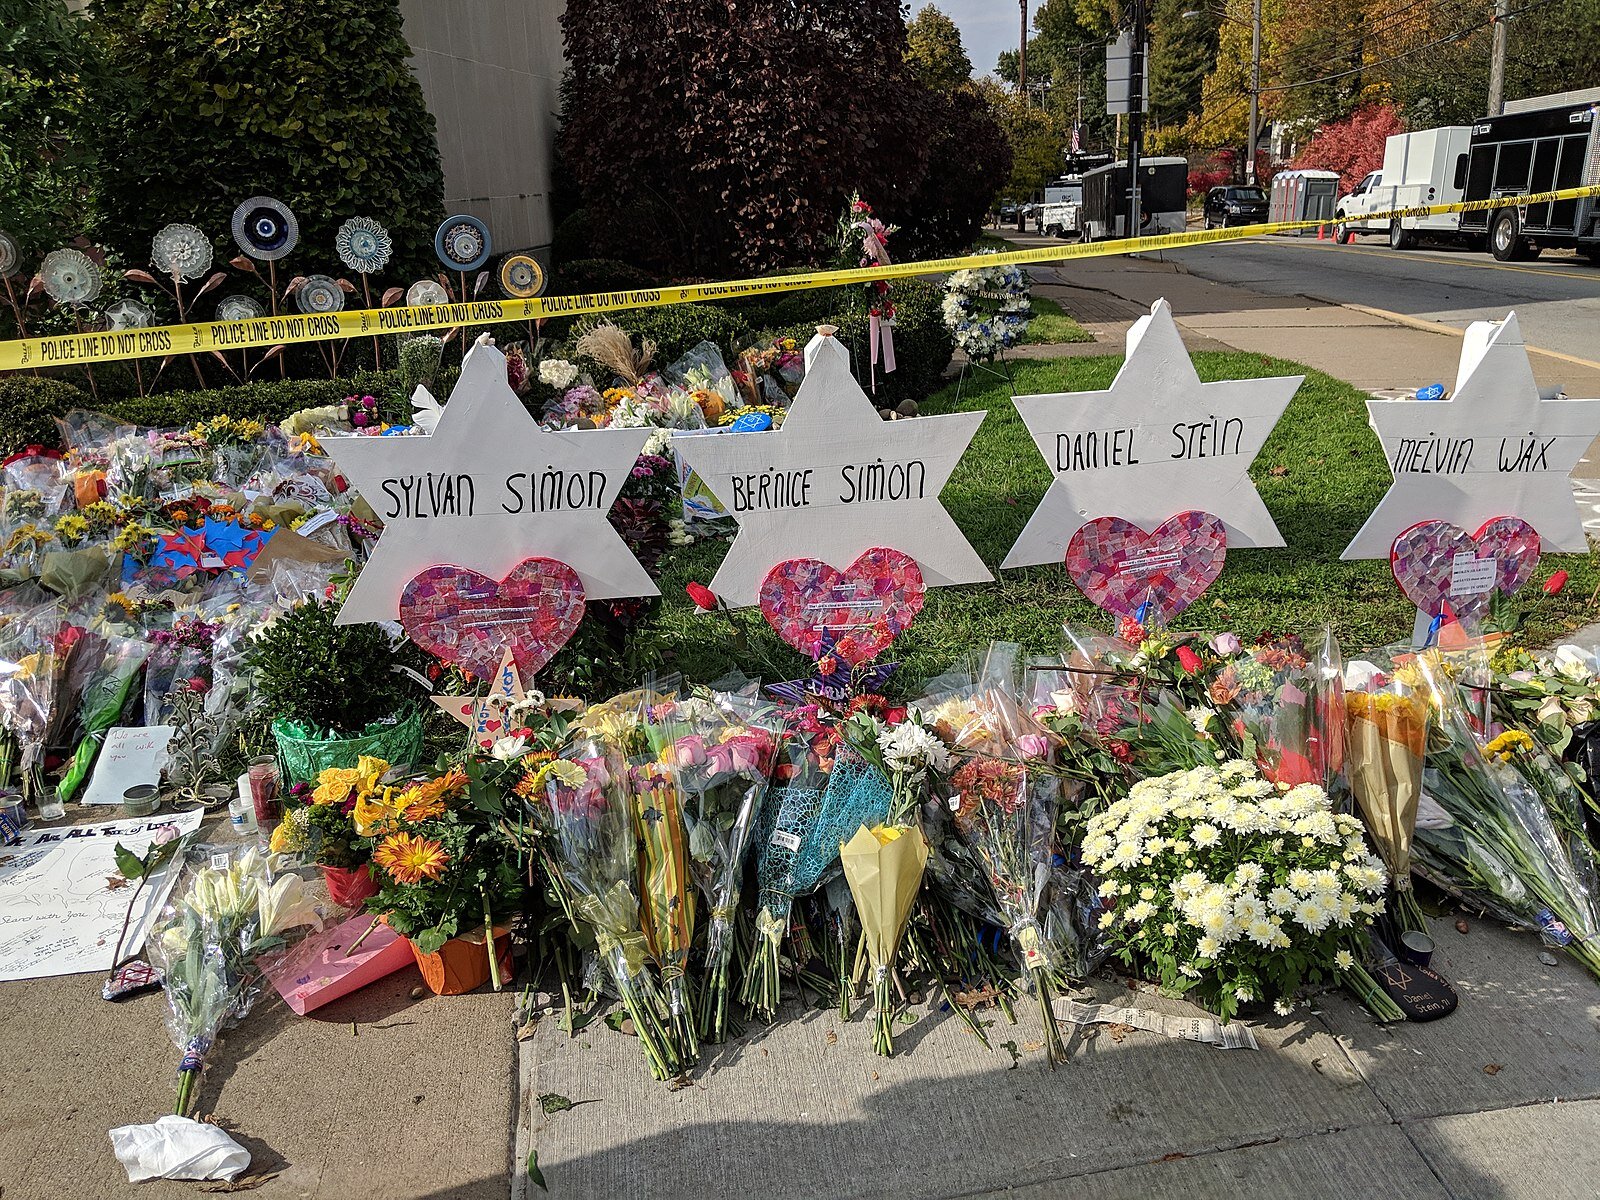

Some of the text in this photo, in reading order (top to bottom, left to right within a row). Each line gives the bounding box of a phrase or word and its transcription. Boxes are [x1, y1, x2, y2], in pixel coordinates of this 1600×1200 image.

[212, 315, 340, 345] POLICE LINE DO NOT CROSS
[379, 310, 412, 329] POLICE
[414, 306, 435, 325] LINE
[436, 306, 450, 323] DO
[452, 304, 470, 320] NOT
[472, 302, 503, 319] CROSS
[42, 331, 171, 361] POLICE LINE DO NOT CROSS
[1056, 415, 1244, 472] DANIEL STEIN
[1394, 433, 1556, 474] MELVIN WAX
[382, 466, 607, 518] SYLVAN SIMON
[732, 467, 813, 512] BERNICE
[840, 458, 926, 503] SIMON
[1402, 992, 1434, 1004] Daniel
[1442, 998, 1451, 1006] 71
